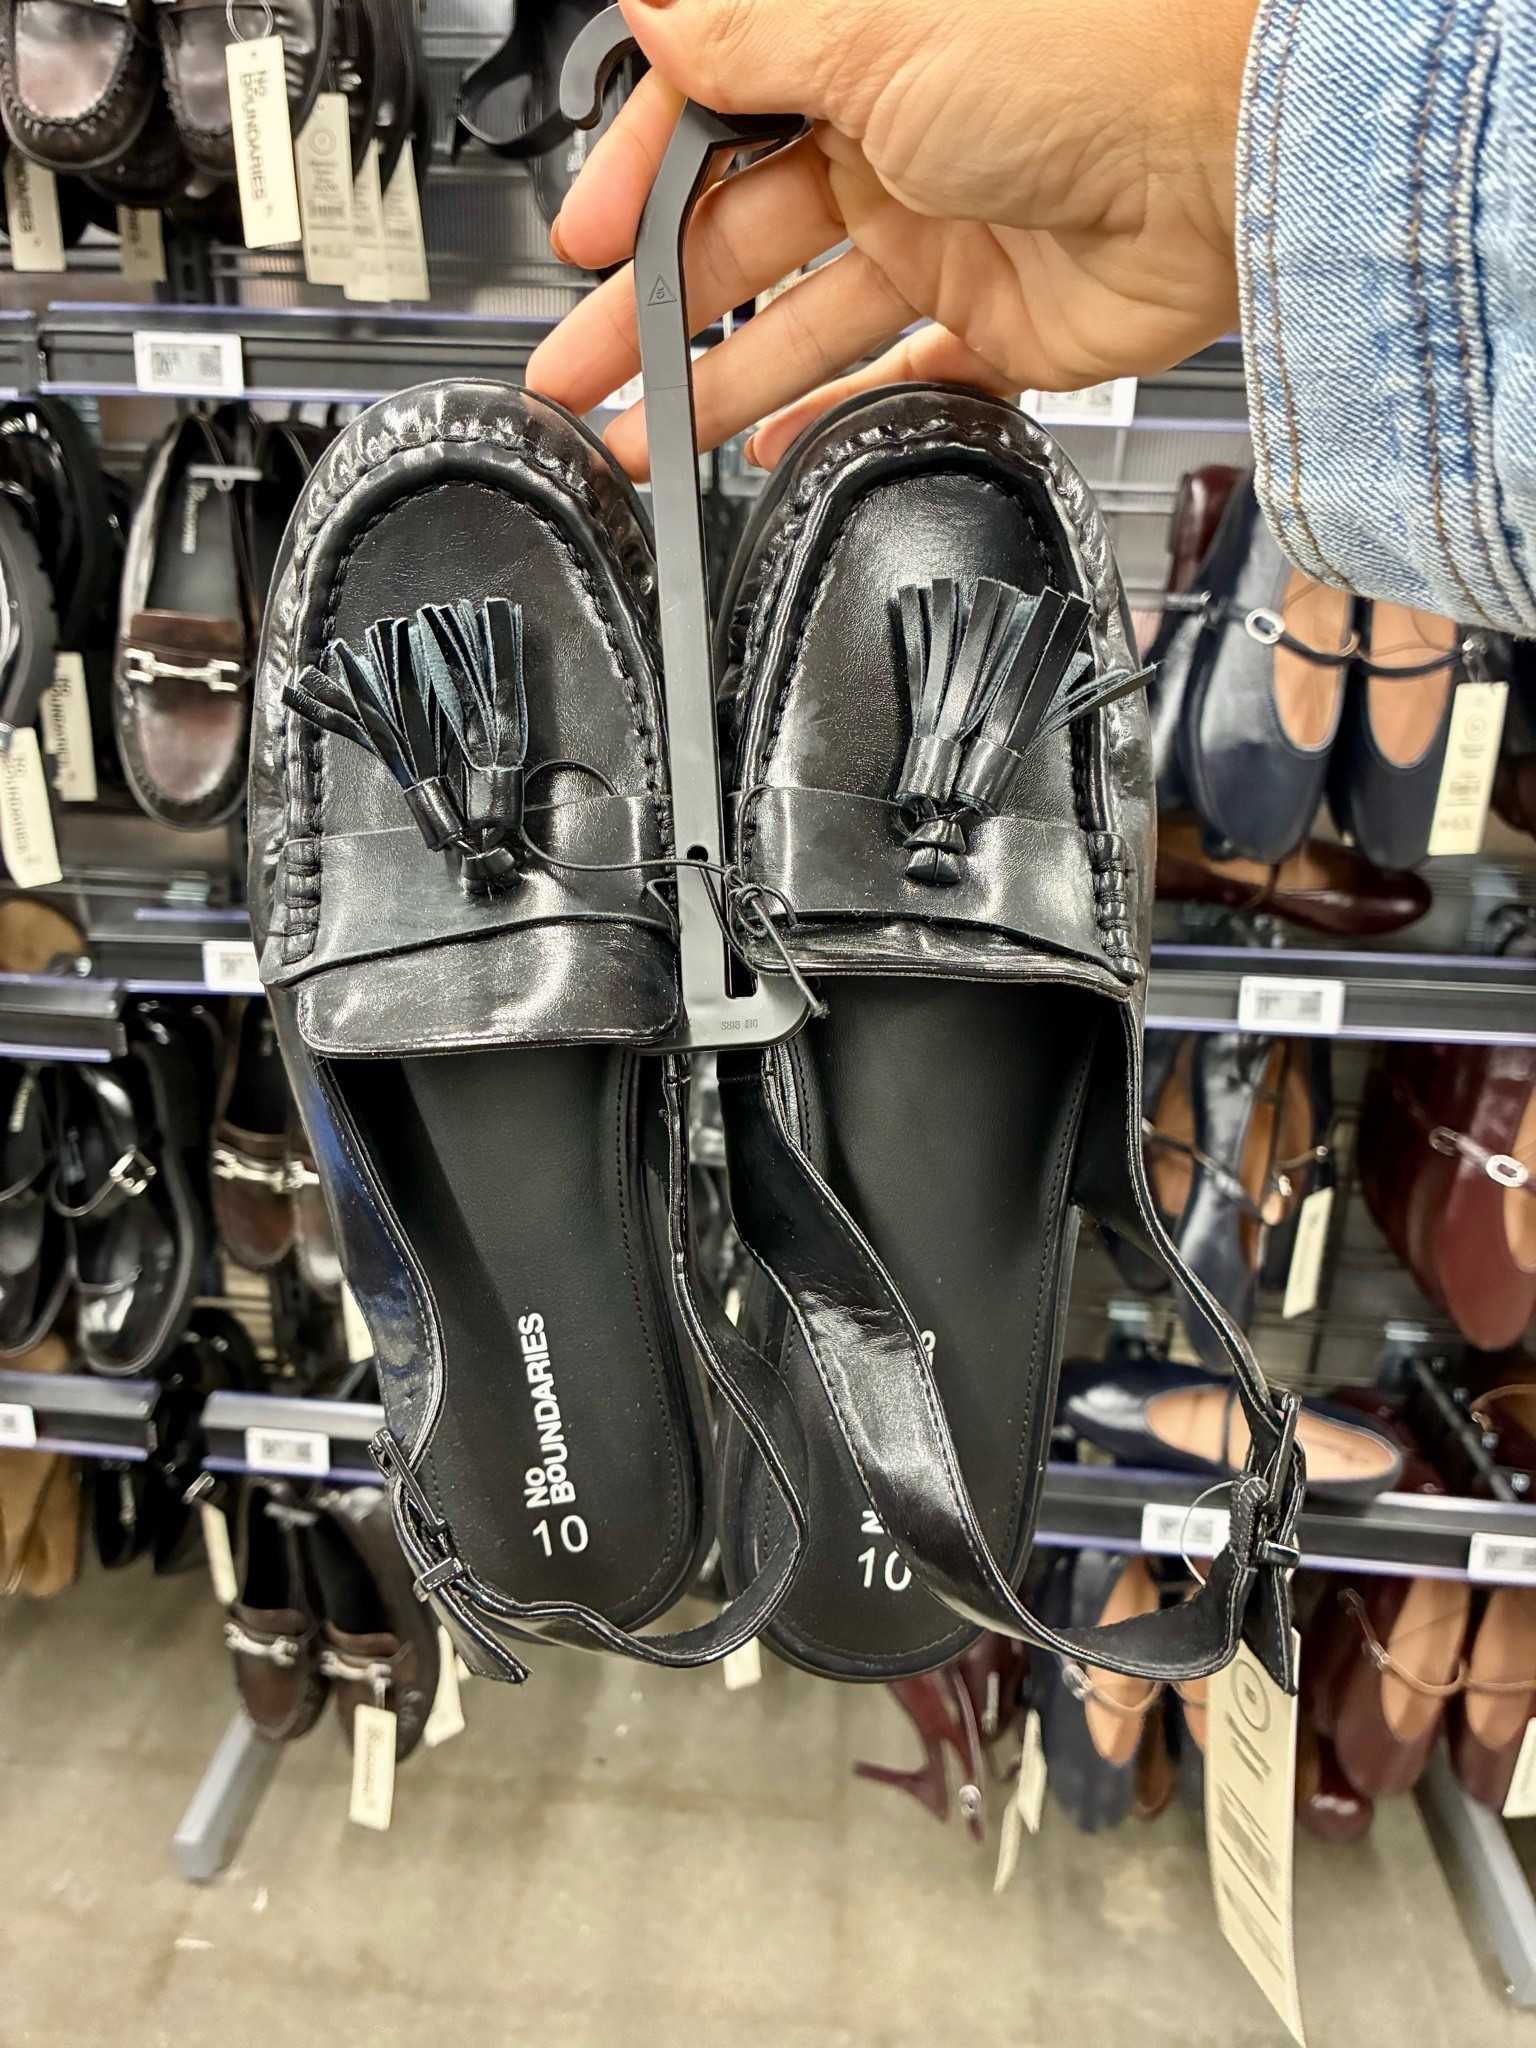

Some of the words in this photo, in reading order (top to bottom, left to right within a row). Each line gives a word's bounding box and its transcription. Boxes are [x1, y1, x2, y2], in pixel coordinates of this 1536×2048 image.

[518, 1311, 577, 1505] BOUNDARIES
[532, 1514, 589, 1557] 10
[857, 1546, 912, 1591] 10
